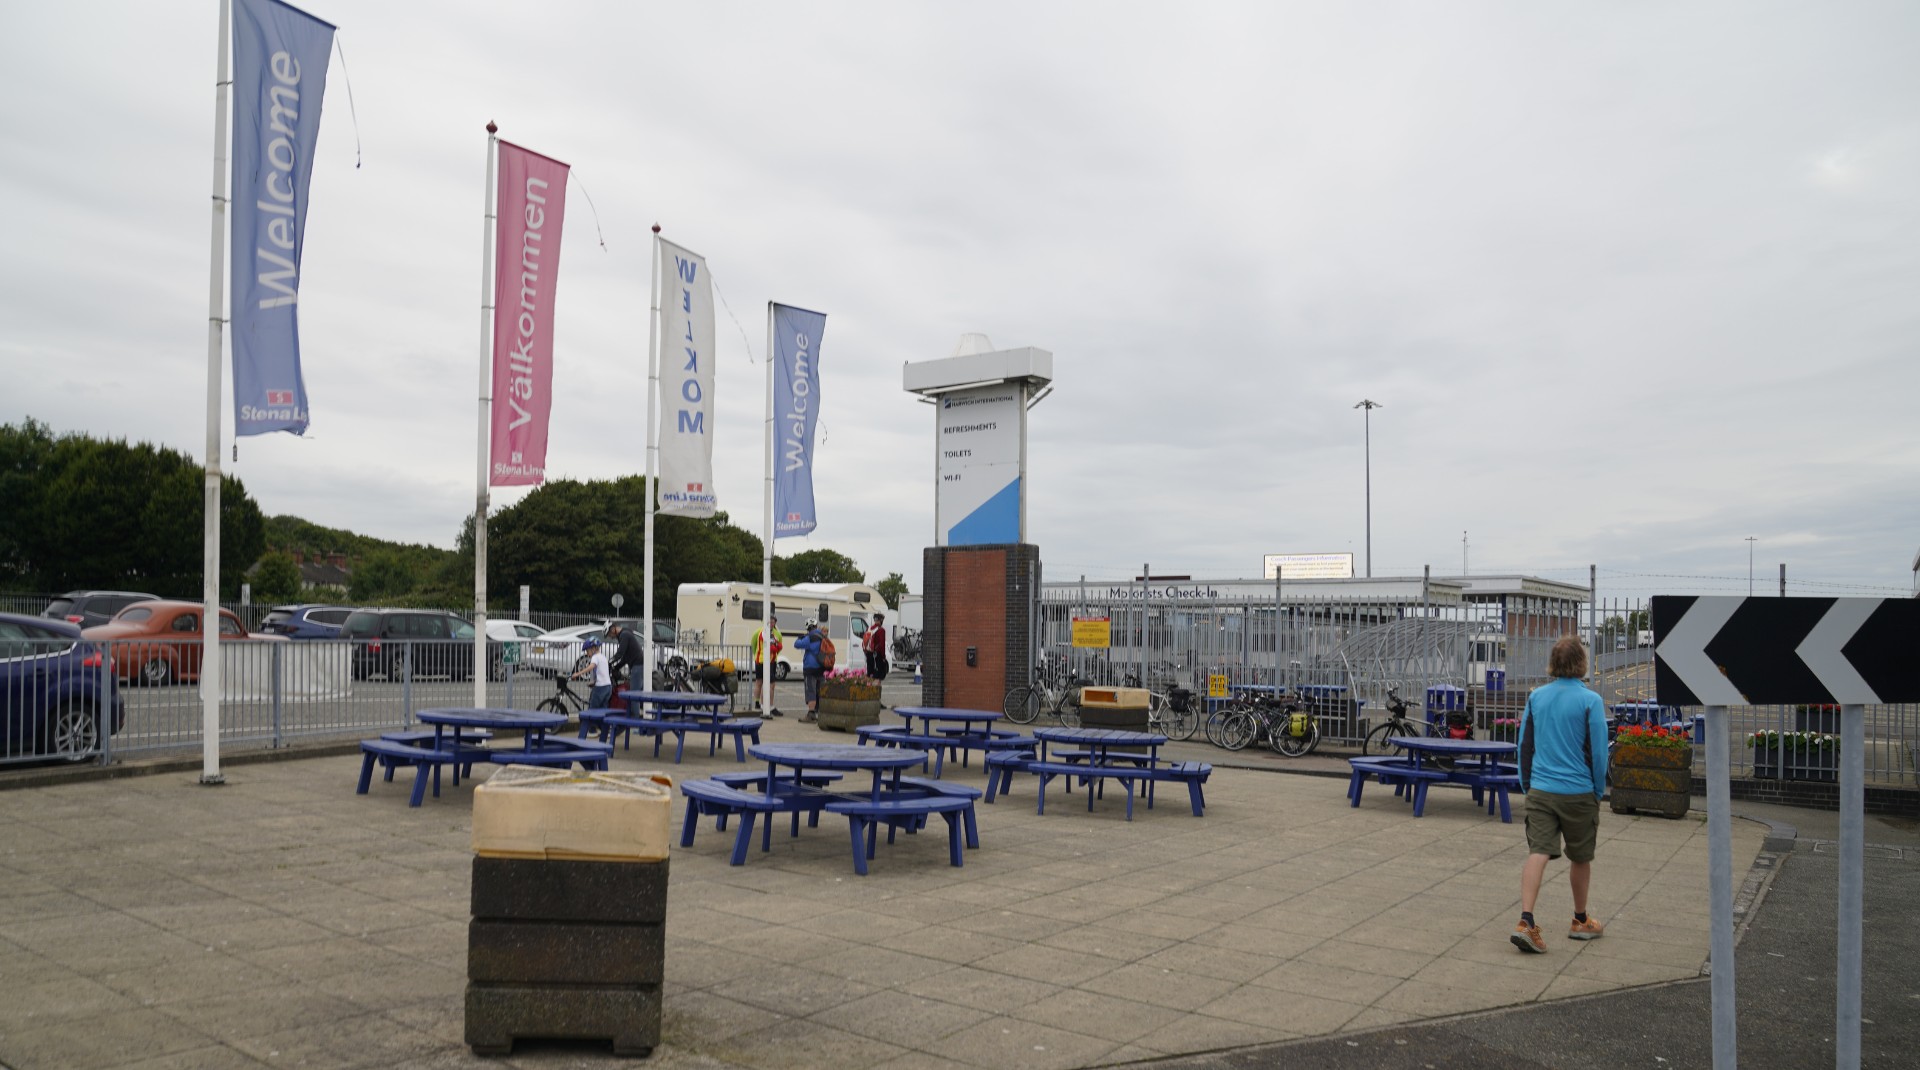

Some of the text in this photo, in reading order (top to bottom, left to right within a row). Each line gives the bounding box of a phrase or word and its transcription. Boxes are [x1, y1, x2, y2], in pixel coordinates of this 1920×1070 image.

[257, 49, 302, 310] Welcome
[509, 176, 549, 432] Välkommen
[785, 332, 809, 473] Welcome
[952, 399, 975, 408] HARWICH
[975, 395, 1013, 405] INTERNATIONAL
[241, 404, 291, 421] Stena
[944, 422, 997, 435] REFRESHMENTS
[944, 449, 972, 458] TOILETS
[494, 463, 522, 476] Stena
[944, 474, 961, 482] WI-FI
[776, 521, 800, 531] Stena
[1109, 586, 1163, 599] Moorsts
